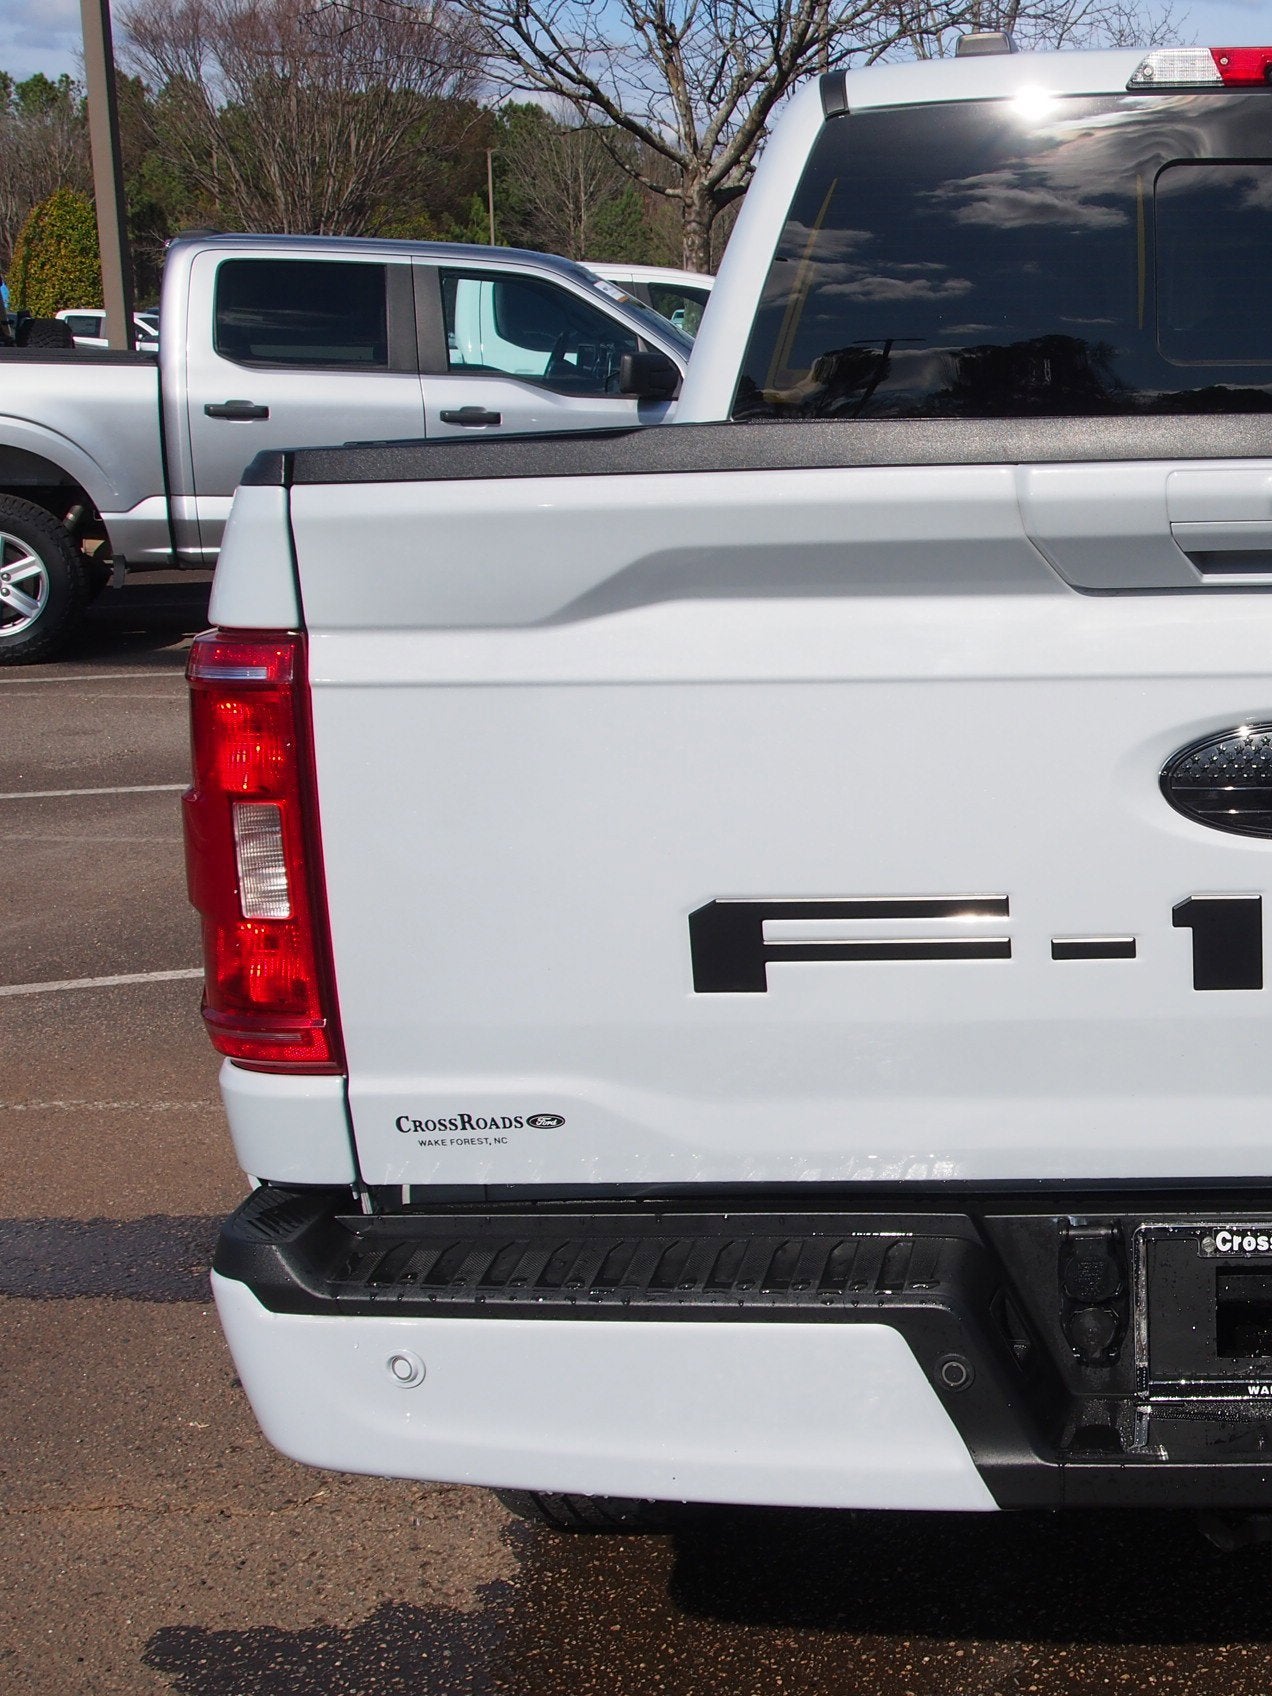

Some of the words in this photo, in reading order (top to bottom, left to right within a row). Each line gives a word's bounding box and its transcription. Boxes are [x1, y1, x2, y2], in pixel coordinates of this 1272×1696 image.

[418, 1138, 447, 1147] WAKE
[450, 1137, 492, 1146] FOREST,
[494, 1136, 508, 1145] NC
